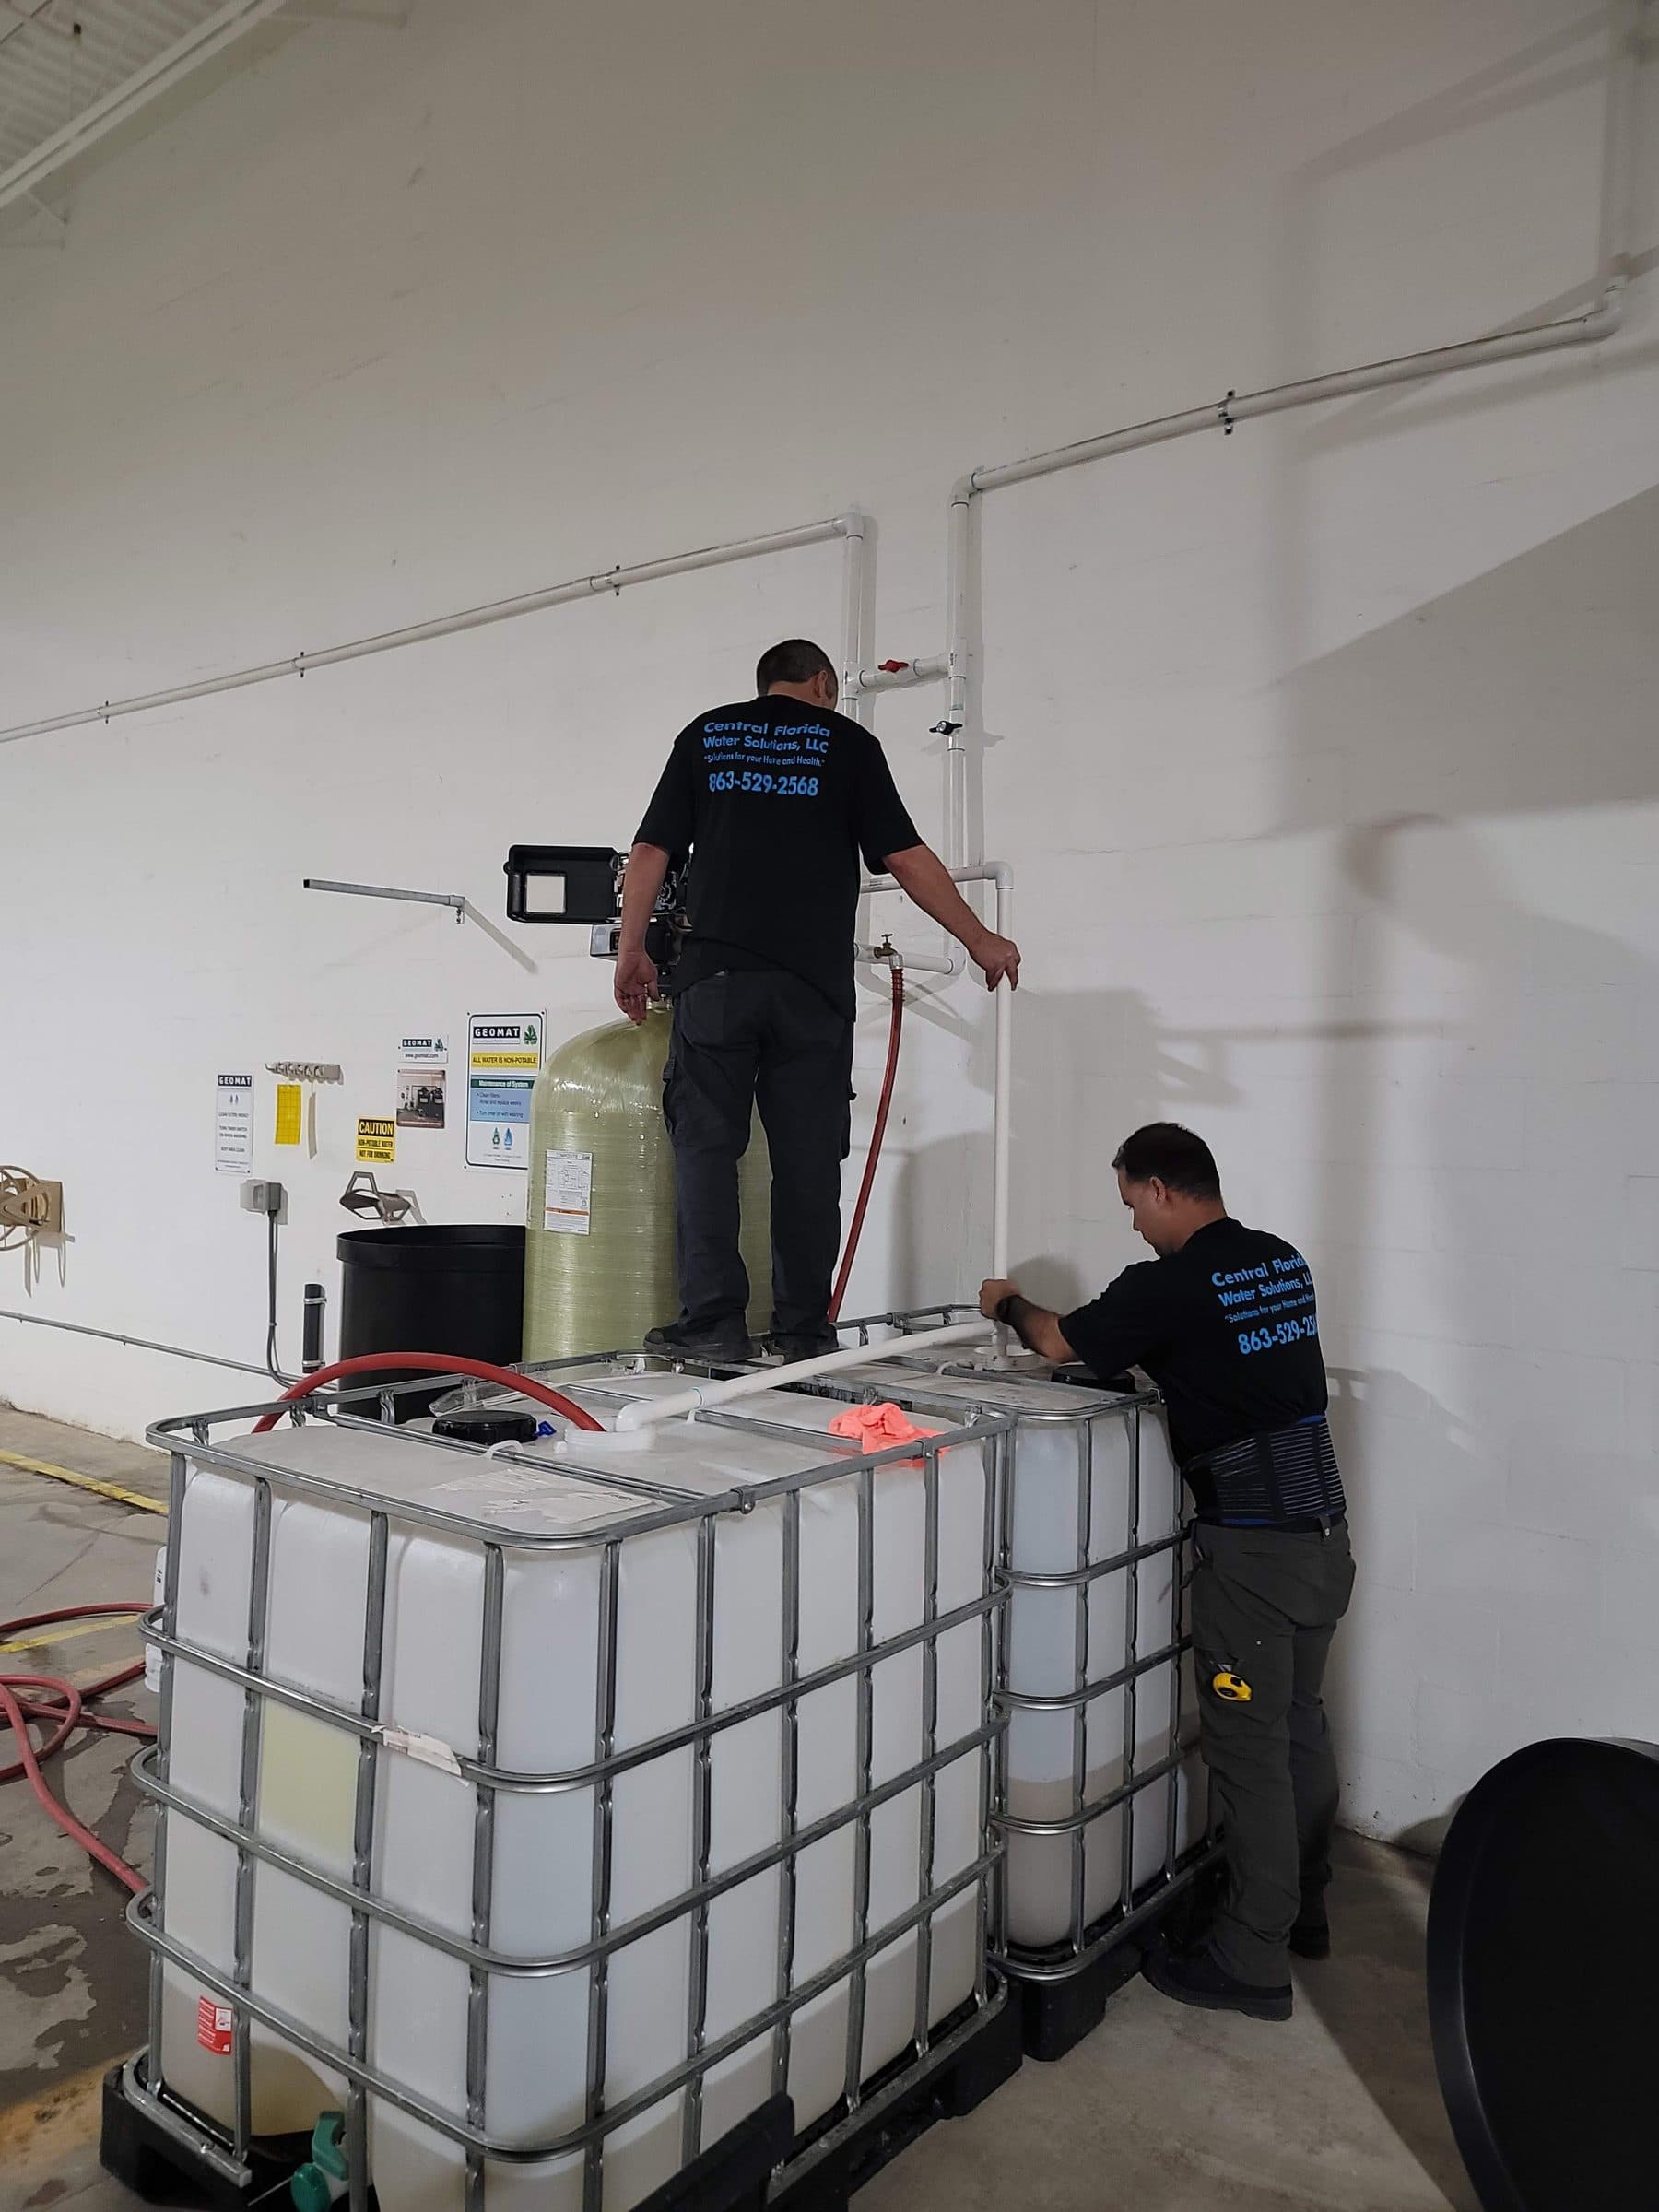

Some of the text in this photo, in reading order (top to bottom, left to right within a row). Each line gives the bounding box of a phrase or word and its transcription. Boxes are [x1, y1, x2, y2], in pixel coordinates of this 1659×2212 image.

[703, 721, 830, 736] Central Florida
[703, 736, 829, 753] Water Solutions, LLC
[735, 752, 745, 760] for
[746, 755, 762, 763] your
[709, 771, 818, 796] 863-529-2568
[475, 1028, 519, 1037] GEOMAT
[219, 1077, 251, 1085] GEOMAT
[359, 1122, 393, 1135] CAUTION
[1211, 1253, 1307, 1287] Central Florid
[1218, 1272, 1312, 1307] Water Solutions, LL
[1238, 1313, 1317, 1355] 863-529-25
